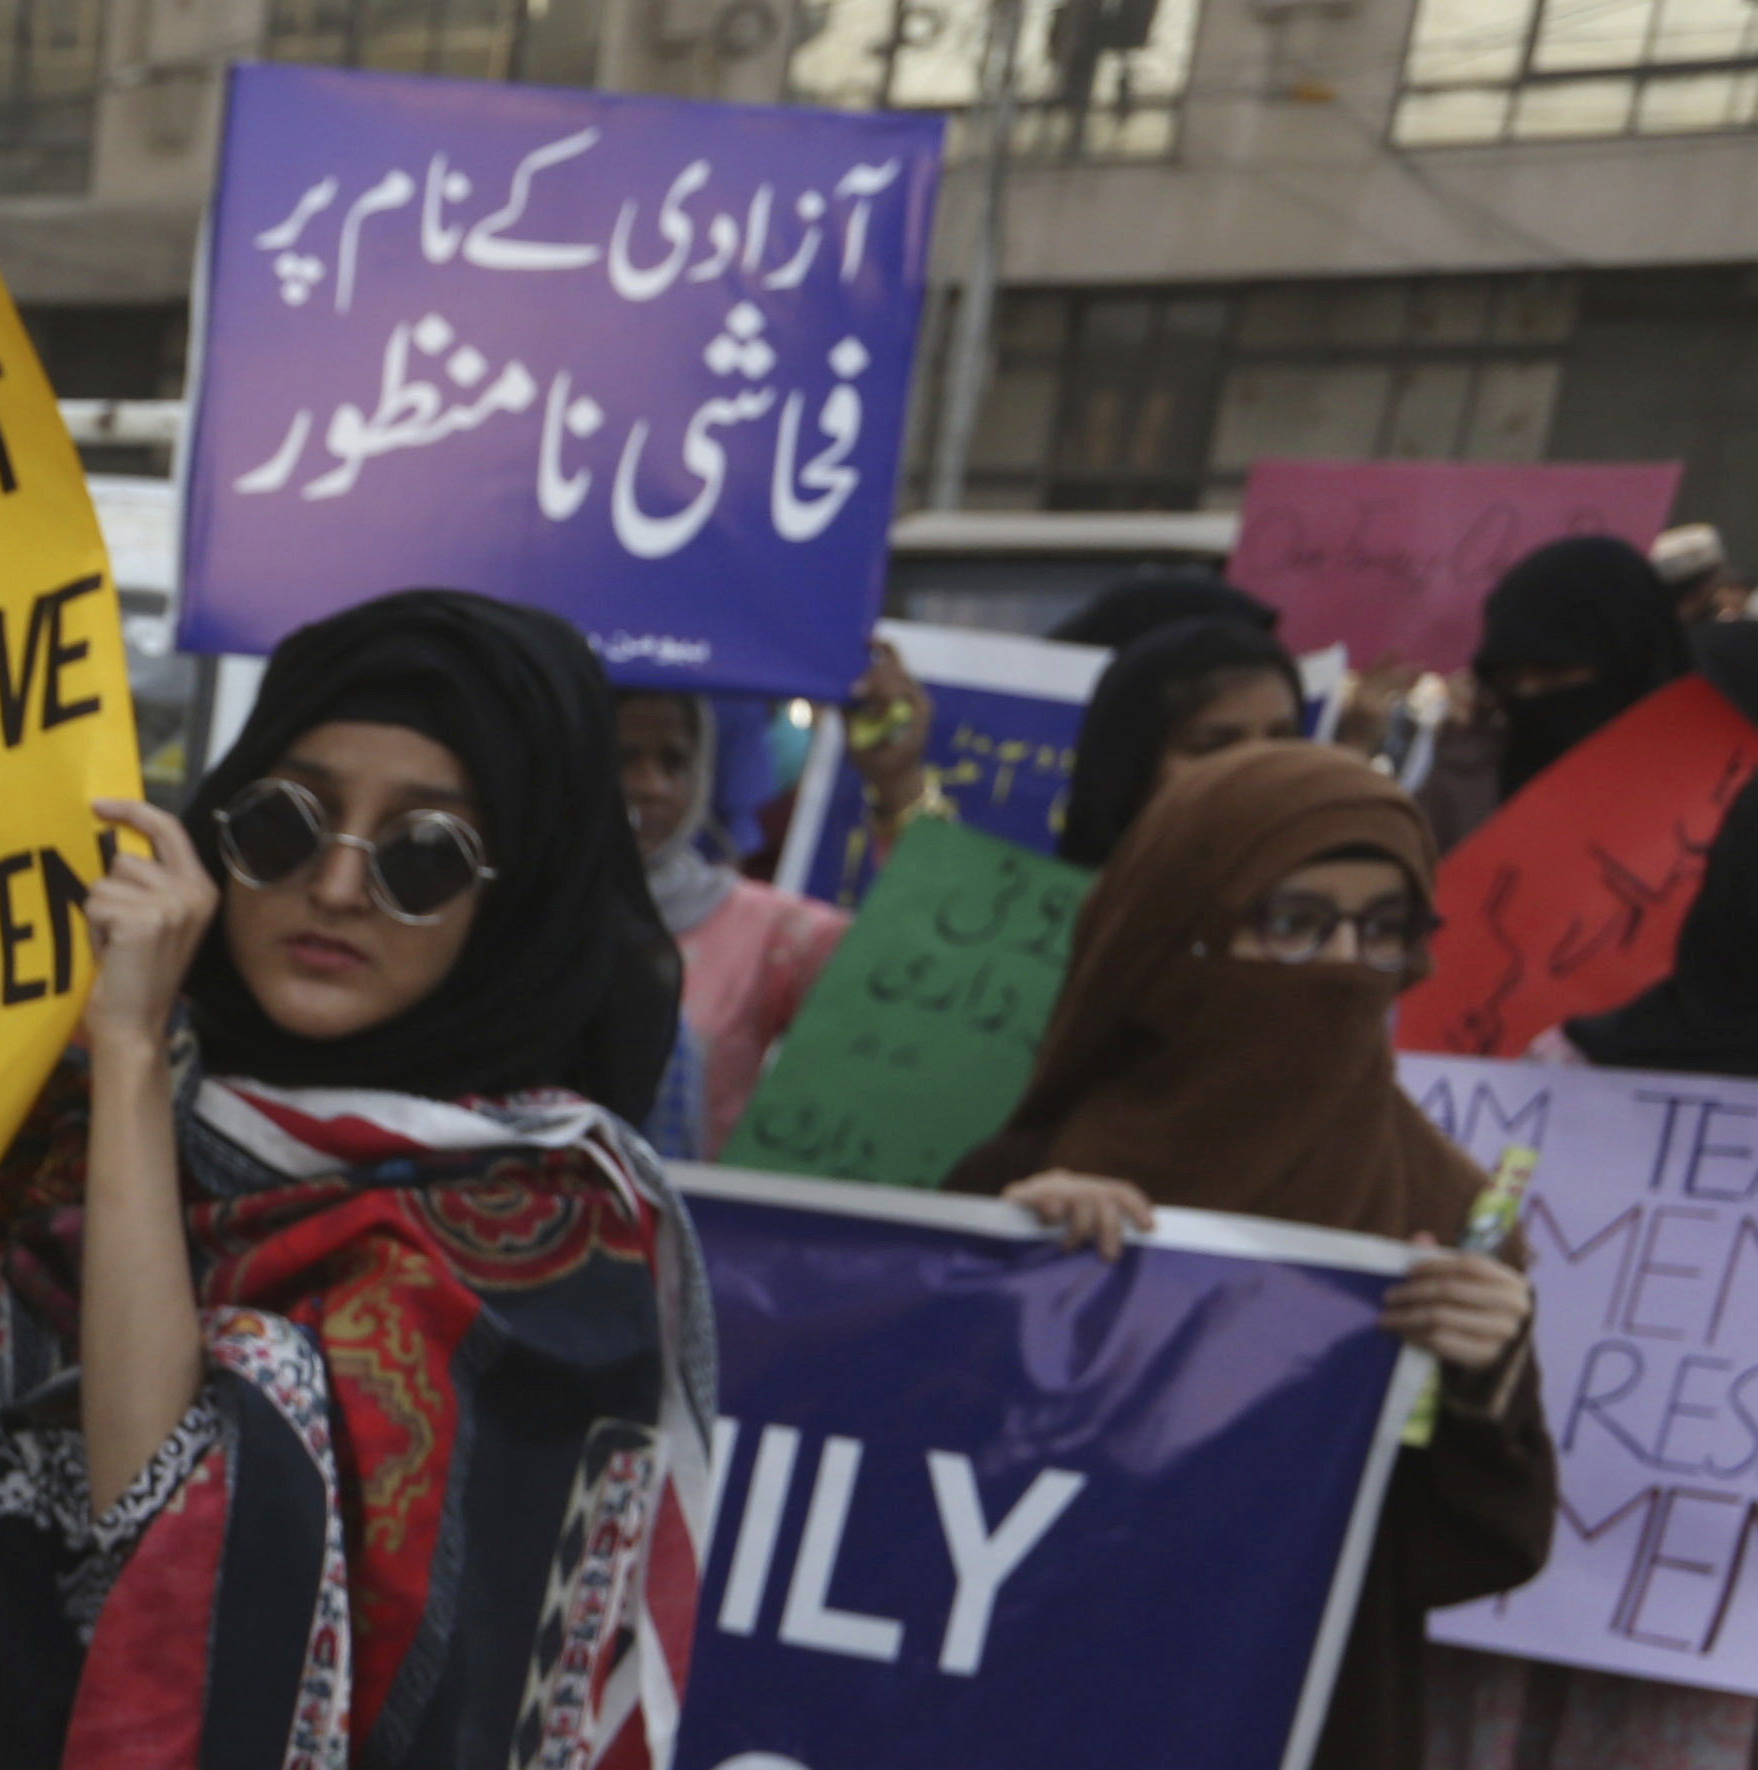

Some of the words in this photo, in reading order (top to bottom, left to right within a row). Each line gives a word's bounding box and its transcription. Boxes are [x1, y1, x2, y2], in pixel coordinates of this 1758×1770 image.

[255, 173, 338, 307] پر
[334, 151, 472, 315] نام
[462, 125, 604, 271] کے
[607, 158, 900, 301] آزادی
[611, 301, 871, 560] فحاشی
[1419, 1077, 1552, 1160] AM
[1632, 1087, 1758, 1204] TE
[1561, 1337, 1758, 1479] RES
[708, 1416, 1085, 1676] ILY
